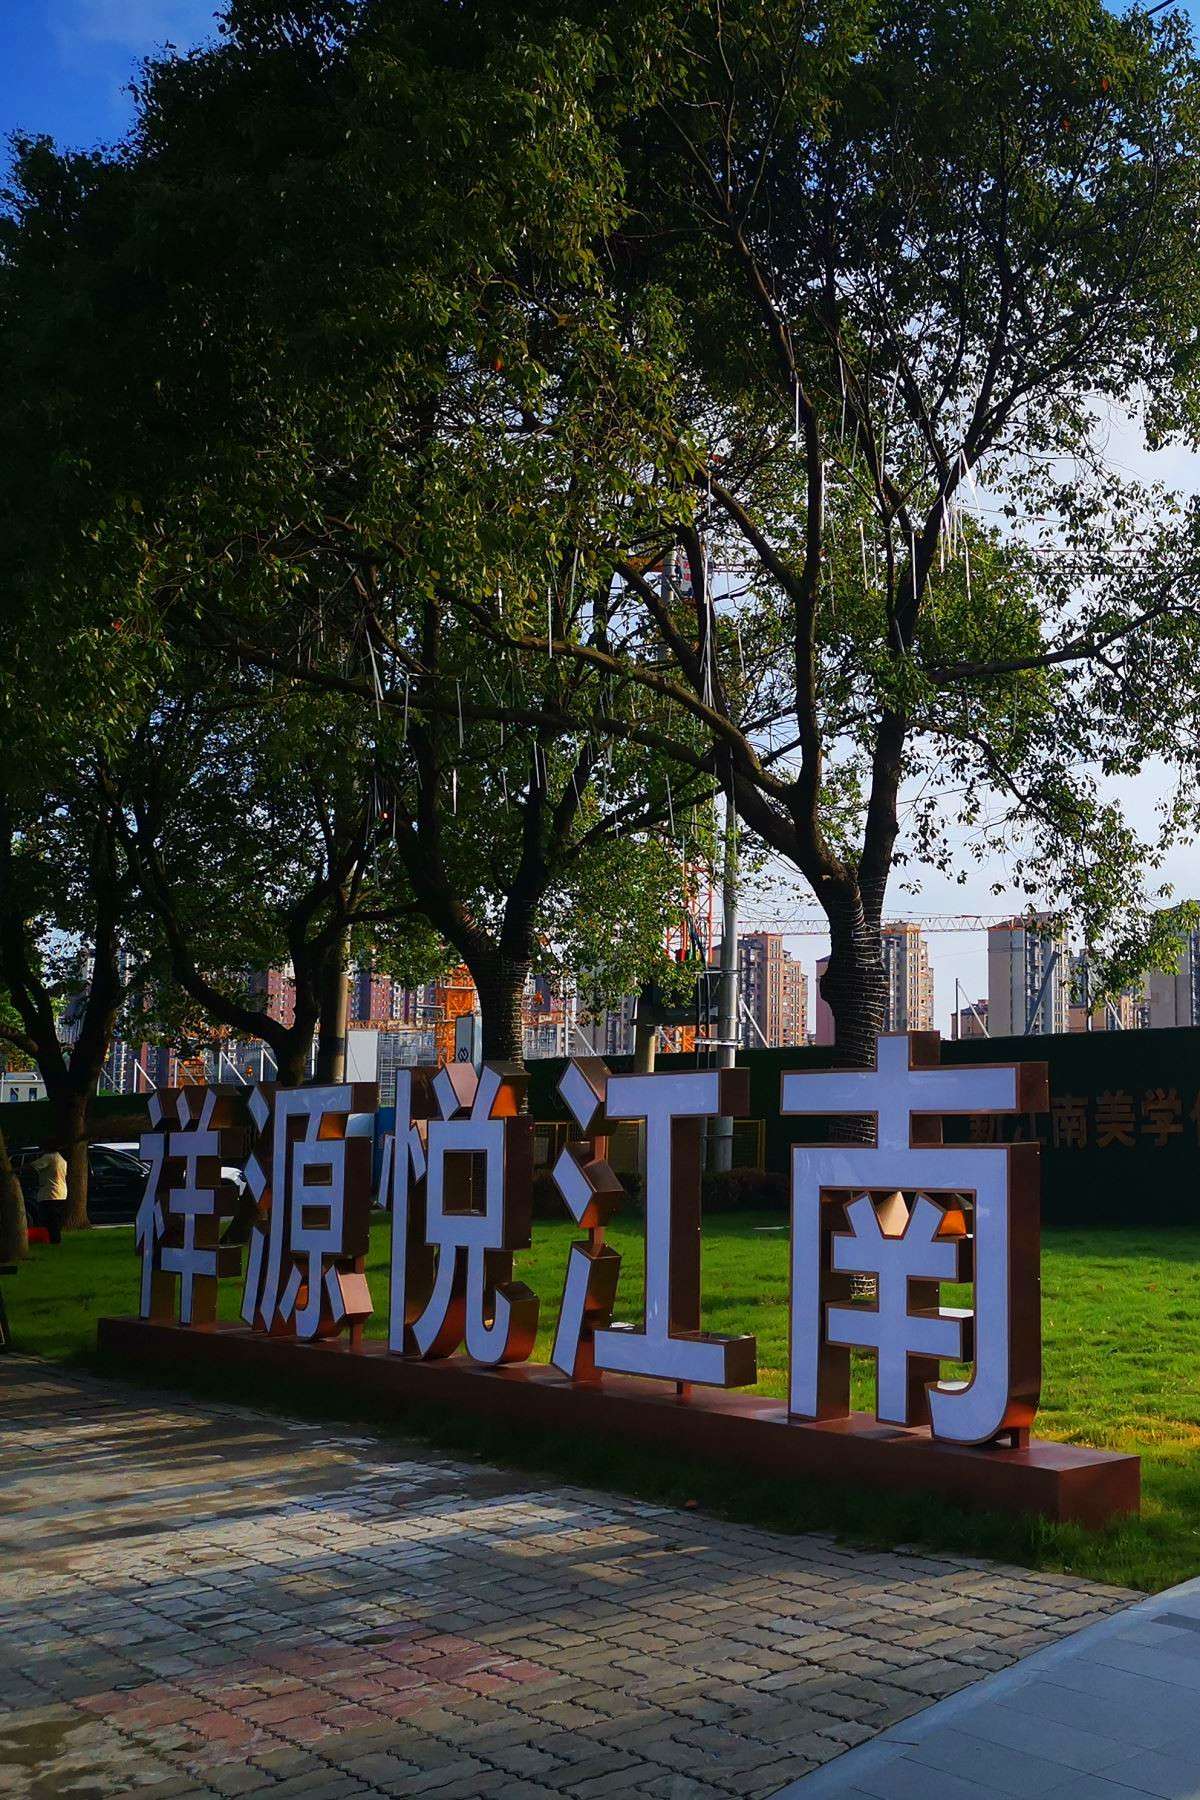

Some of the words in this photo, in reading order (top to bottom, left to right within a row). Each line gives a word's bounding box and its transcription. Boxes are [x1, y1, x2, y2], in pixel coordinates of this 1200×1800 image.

[134, 1031, 1048, 1445] 祥源悦江南
